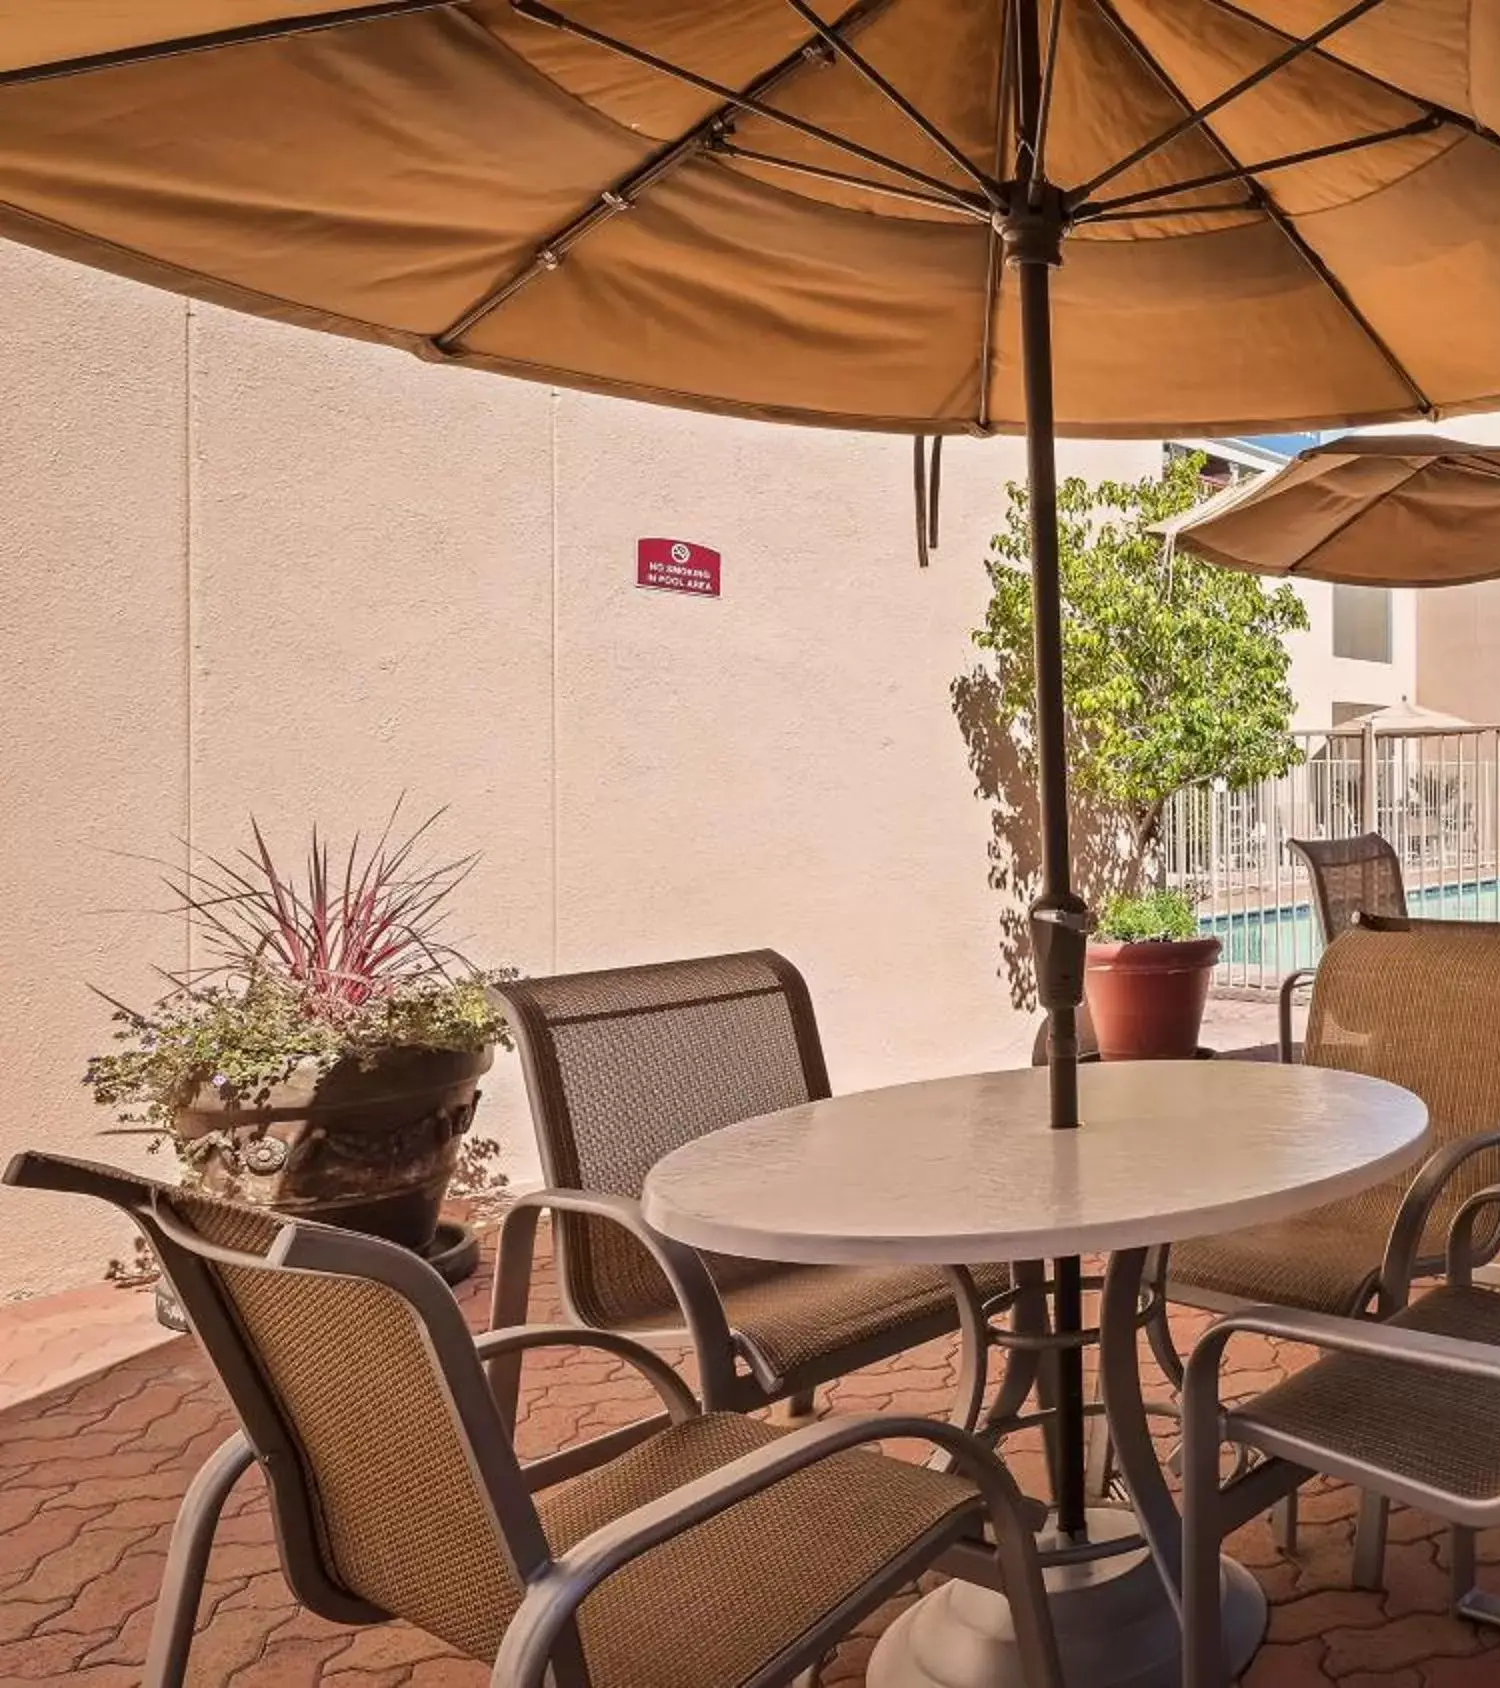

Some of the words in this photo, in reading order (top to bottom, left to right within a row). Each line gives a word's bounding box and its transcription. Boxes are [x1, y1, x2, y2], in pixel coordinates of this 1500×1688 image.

[649, 562, 664, 573] NO
[666, 564, 711, 579] SMOKING
[648, 573, 657, 583] IN
[657, 575, 685, 587] POOL
[688, 579, 713, 591] AREA
